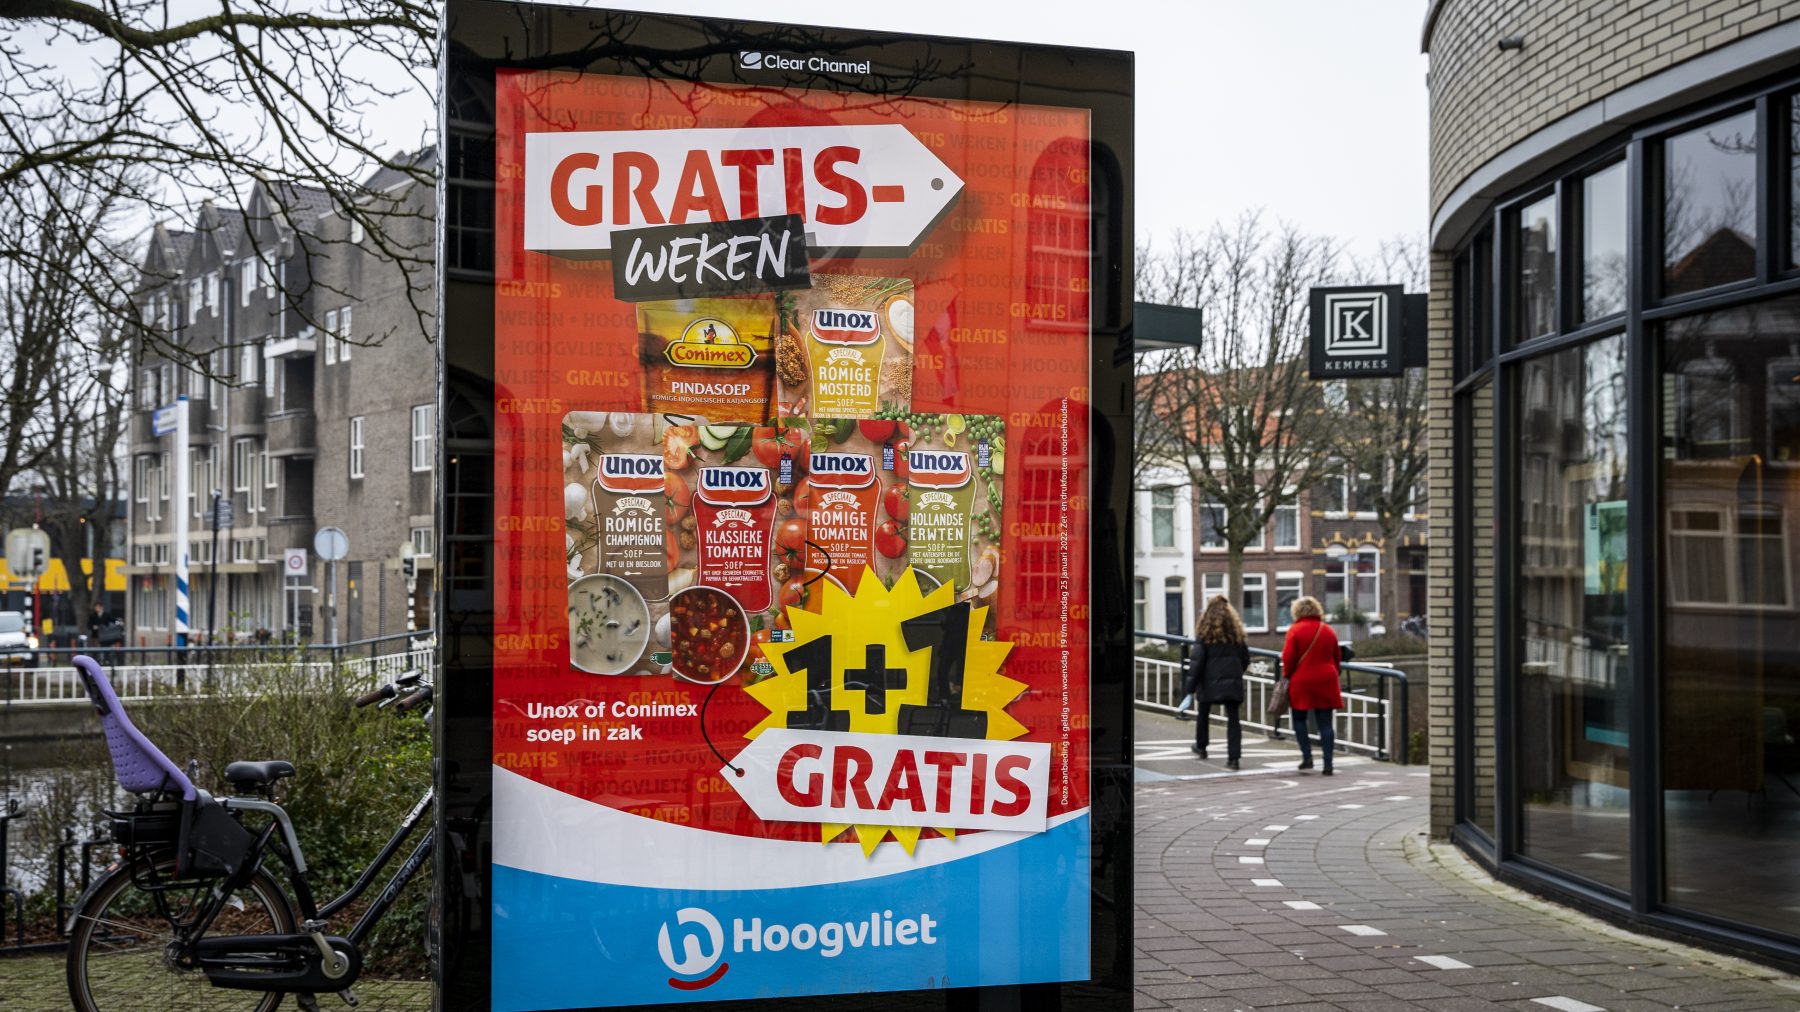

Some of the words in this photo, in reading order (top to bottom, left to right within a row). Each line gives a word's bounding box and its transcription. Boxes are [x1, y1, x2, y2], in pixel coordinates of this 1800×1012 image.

[764, 54, 805, 71] Clear
[808, 56, 871, 75] Channel
[631, 112, 695, 129] GRATIS
[951, 105, 1009, 124] GRATIS
[950, 134, 1007, 151] WEKEN
[966, 163, 1066, 181] HOOGVLIETS
[549, 145, 905, 226] GRATIS-
[1009, 192, 1067, 210] GRATIS
[950, 217, 1009, 234] GRATIS
[625, 228, 792, 287] WEKEN
[950, 246, 1007, 262] WEKEN
[498, 280, 562, 298] GRATIS
[500, 310, 564, 328] WEKEN
[1009, 302, 1067, 319] GRATIS
[819, 310, 873, 329] unox
[1342, 310, 1370, 339] K
[950, 327, 1008, 344] GRATIS
[512, 340, 627, 358] HOOGVLIETS
[674, 345, 746, 363] Conimex
[833, 348, 857, 358] SPECIAAL
[1324, 359, 1388, 370] KEMPKES
[566, 369, 630, 387] GRATIS
[818, 366, 872, 383] ROMIGE
[671, 381, 751, 397] PINDASOEP
[819, 383, 872, 397] MOSTERD
[965, 383, 1065, 400] HOOGVLIETS
[498, 398, 562, 414] GRATIS
[836, 398, 854, 407] SOEP
[1008, 411, 1066, 428] GRATIS
[1060, 396, 1069, 456] voorbehouden.
[605, 456, 664, 476] unox
[812, 455, 869, 473] unox
[910, 453, 965, 471] unox
[705, 470, 764, 488] unox
[1060, 457, 1069, 500] drukfouten
[621, 498, 646, 509] SPECIAAL
[826, 492, 852, 502] SPECIAAL
[924, 493, 950, 503] SPECIAAL
[1060, 501, 1069, 511] en
[497, 515, 562, 532] GRATIS
[721, 510, 747, 520] SPECIAAL
[811, 511, 868, 527] ROMIGE
[910, 512, 964, 526] HOLLANDSE
[1060, 513, 1069, 528] Zet-
[606, 517, 662, 533] ROMIGE
[1008, 521, 1066, 537] GRATIS
[606, 534, 662, 547] CHAMPIGNON
[705, 530, 763, 545] KLASSIEKE
[811, 527, 868, 542] TOMATEN
[910, 527, 964, 541] ERWTEN
[623, 549, 643, 559] SOEP
[706, 545, 762, 559] TOMATEN
[830, 543, 850, 552] SOEP
[927, 543, 946, 552] SOEP
[606, 560, 617, 568] MET
[724, 561, 743, 570] SOEP
[1060, 552, 1071, 579] januari
[1060, 580, 1069, 590] 25
[1060, 591, 1071, 622] dinsdag
[1060, 623, 1069, 638] t/m
[494, 633, 560, 651] GRATIS
[1008, 631, 1066, 648] GRATIS
[1060, 639, 1069, 648] 19
[1060, 650, 1071, 690] woensdag
[628, 691, 691, 706] GRATIS
[1060, 691, 1069, 705] van
[527, 702, 579, 719] Unox
[585, 700, 606, 718] of
[611, 700, 698, 718] Conimex
[1060, 707, 1071, 732] geldig
[526, 728, 577, 745] soep
[583, 724, 601, 741] in
[606, 724, 643, 741] zak
[494, 751, 559, 768] GRATIS
[563, 750, 627, 768] WEKEN
[1060, 741, 1071, 785] aanbieding
[776, 743, 1032, 818] GRATIS
[1060, 786, 1069, 805] Deze
[733, 909, 937, 958] Hoogvliet
